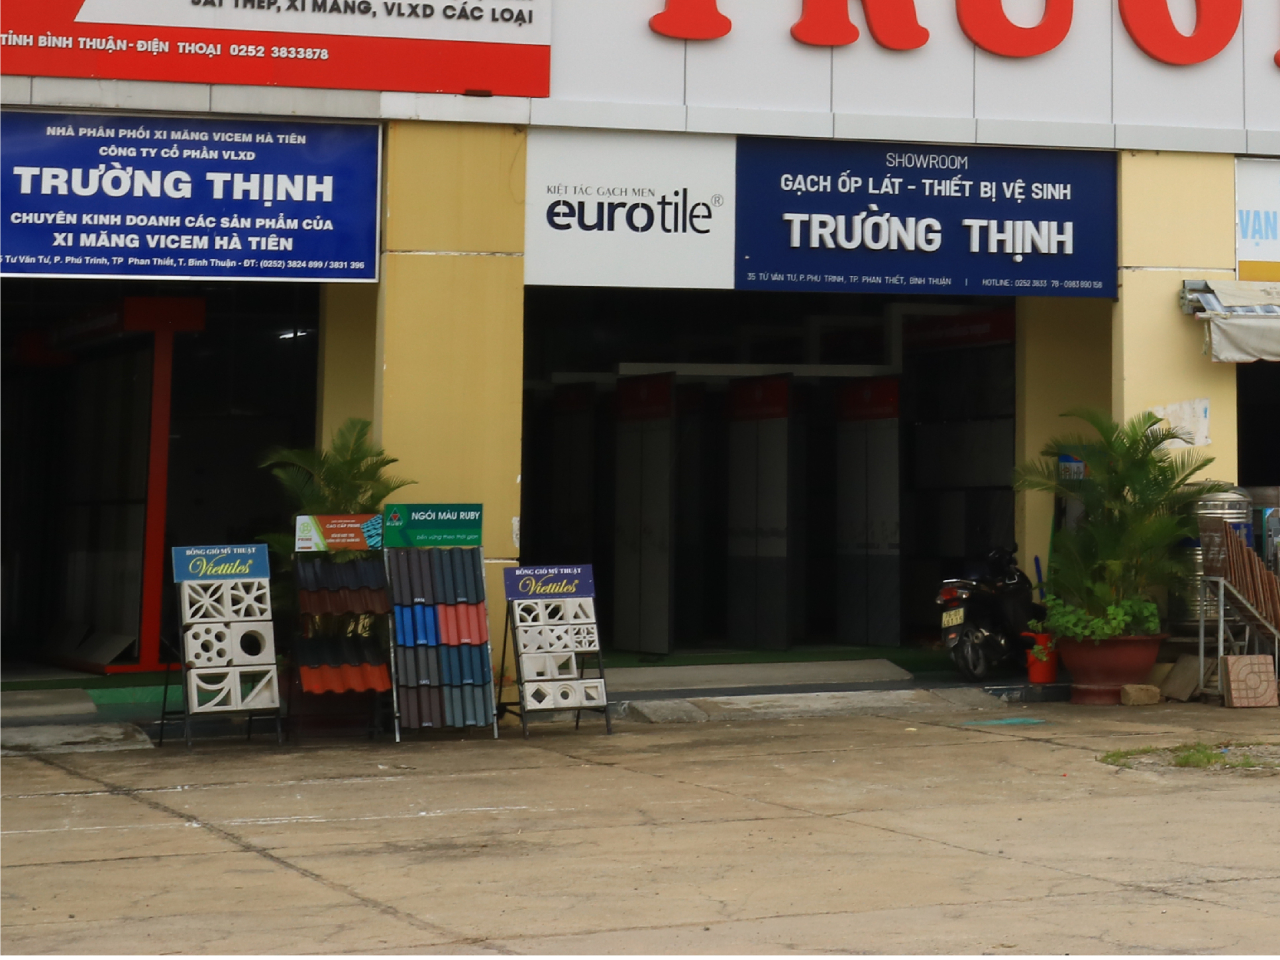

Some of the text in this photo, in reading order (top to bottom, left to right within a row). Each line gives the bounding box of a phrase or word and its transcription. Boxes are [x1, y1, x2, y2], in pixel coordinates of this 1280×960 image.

[384, 2, 435, 19] VLXD
[442, 1, 484, 20] CÁC
[491, 7, 533, 27] LOẠI
[0, 30, 329, 60] TỈNH BÌNH THOẠI 0252 3833878
[46, 125, 306, 144] NHÀ PHÂN PHỐI XI MĂNG VICEM HÀ TIÊN
[99, 144, 256, 161] CÔNG TY CỔ PHẦN VLXD
[886, 152, 968, 170] SHOWROOM
[13, 162, 334, 207] TRƯỜNG THỊNH
[547, 183, 655, 199] KIỆT TÁC GẠCH MEN
[780, 170, 1071, 203] GẠCH ỐP LÁT THIẾT BỊ VỆ SINH
[10, 210, 334, 230] CHUYÊN KINH DOANH CÁC SẢN PHẨM CỦA
[1238, 210, 1277, 247] VẠN
[52, 230, 294, 251] XI MĂNG VICEM HÀ TIÊN
[782, 203, 1073, 262] TRƯỜNG THỊNH
[112, 257, 124, 265] TP
[128, 257, 150, 265] Phan
[152, 257, 177, 267] Thiết,
[210, 259, 236, 268] Thuận
[243, 259, 258, 267] ĐT:
[260, 260, 285, 269] (0252)
[287, 260, 306, 268] 3824
[329, 261, 347, 269] 3831
[411, 509, 435, 520] NGÓI
[438, 509, 457, 520] MÀU
[189, 554, 253, 577] Viettiles
[519, 574, 579, 595] Viettiles
